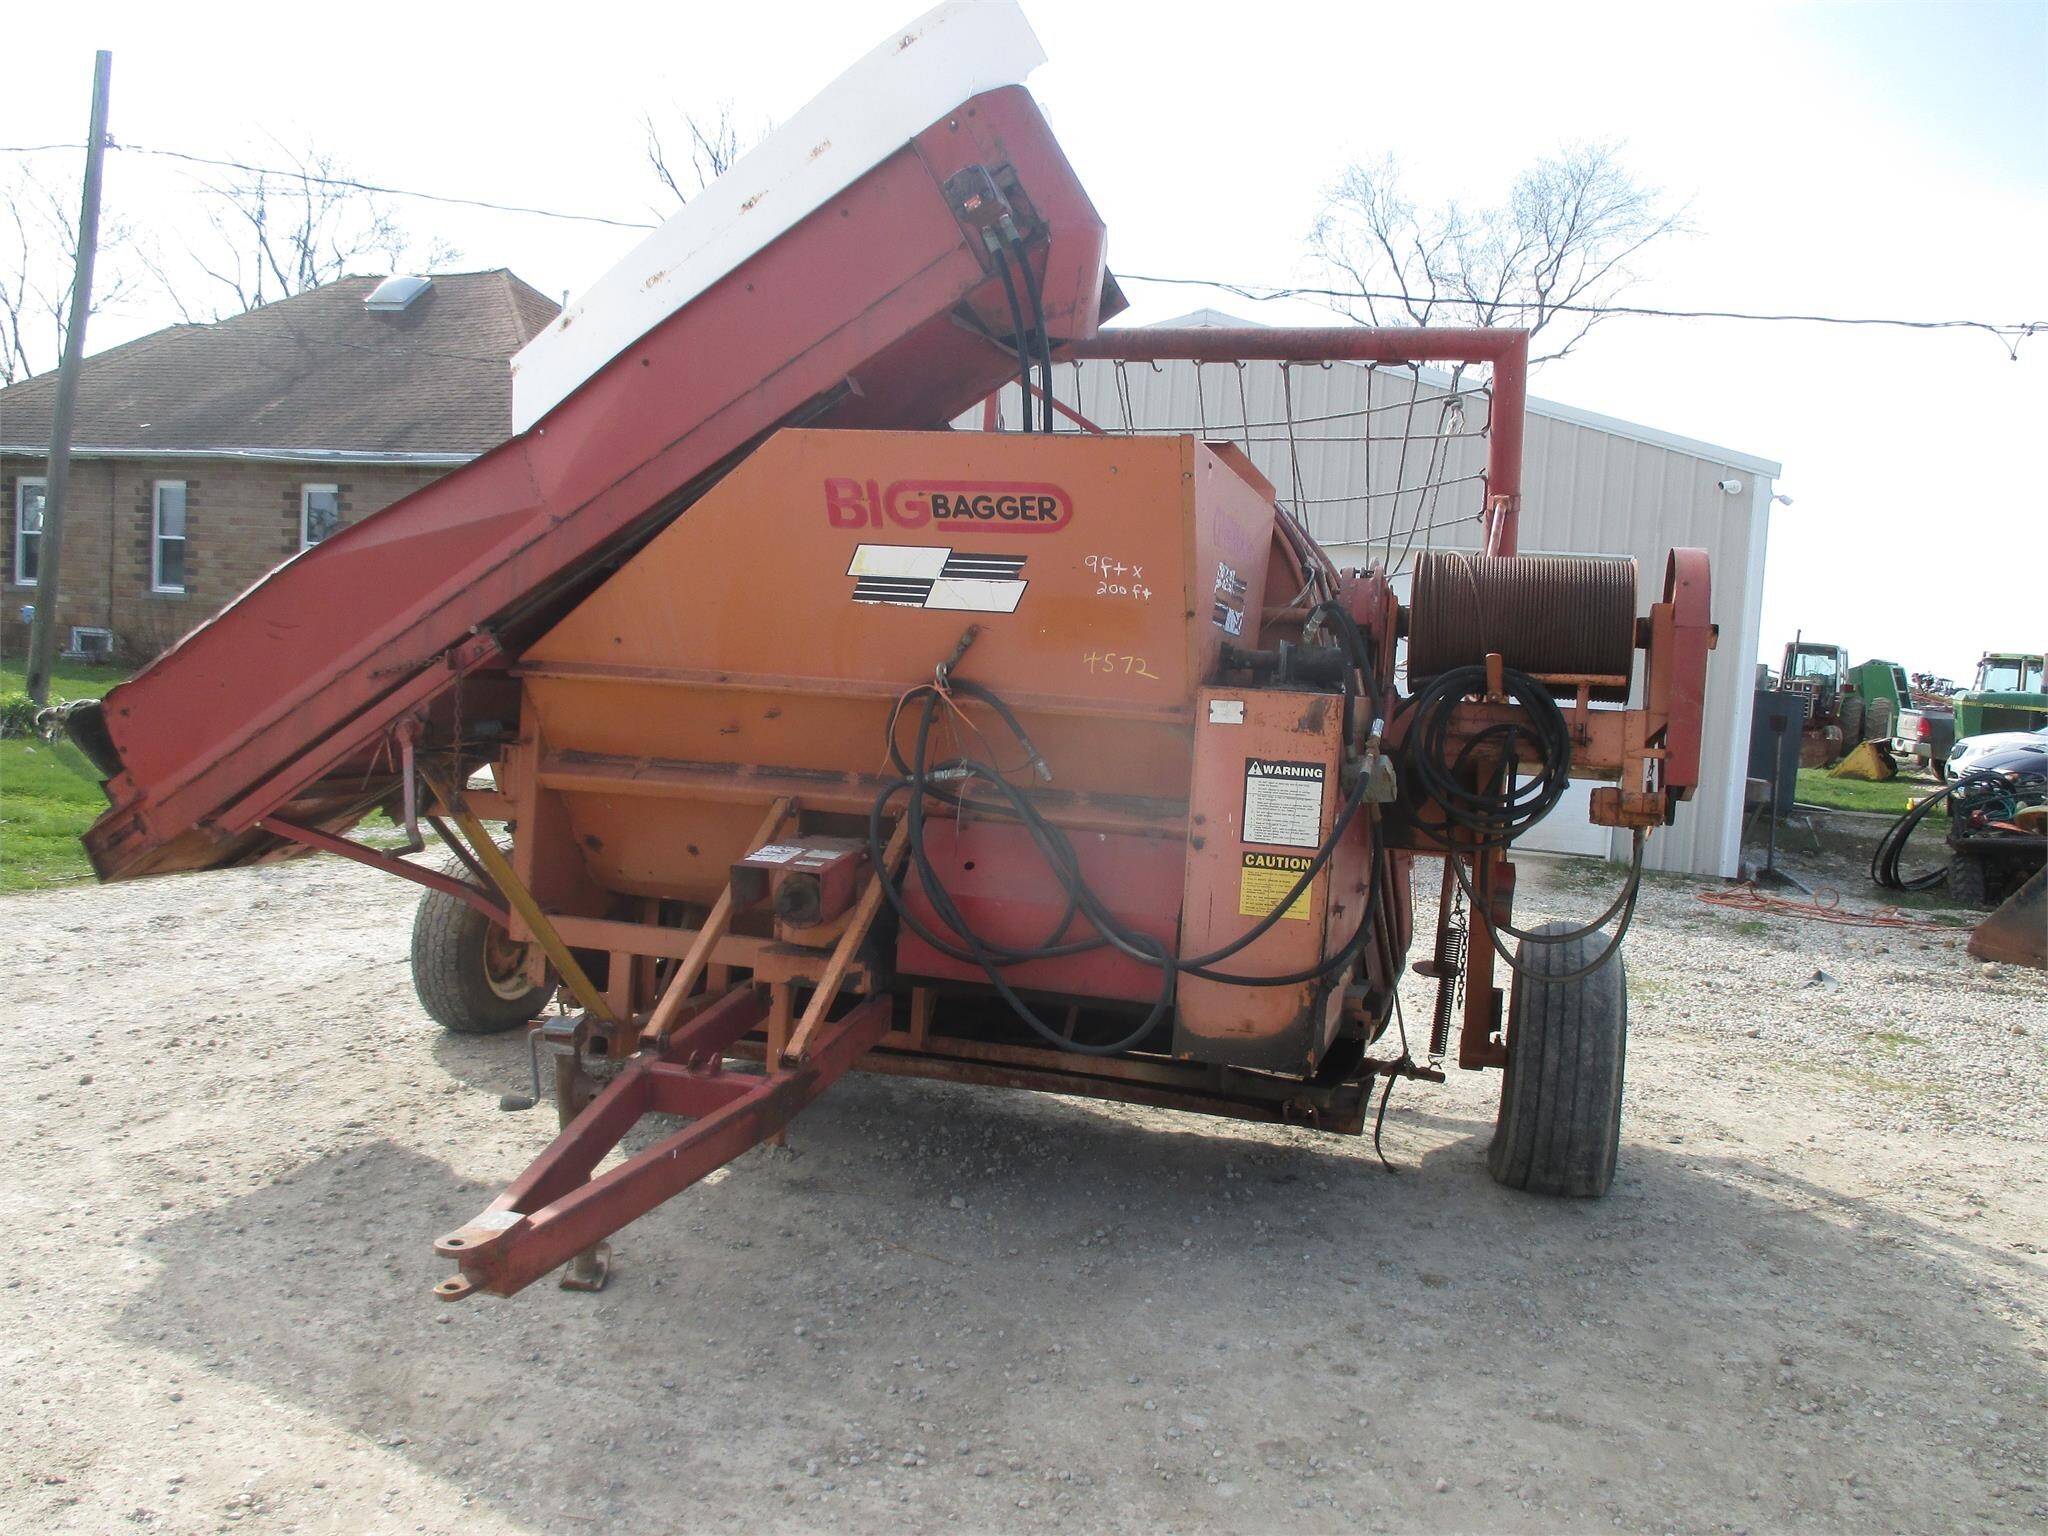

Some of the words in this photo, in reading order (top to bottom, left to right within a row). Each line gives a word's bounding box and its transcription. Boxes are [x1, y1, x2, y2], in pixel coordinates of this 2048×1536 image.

[824, 478, 932, 529] BIG
[931, 494, 1057, 521] BAGGER
[1096, 581, 1127, 595] 200
[1132, 584, 1152, 600] ft
[1082, 652, 1159, 679] 4572
[1263, 765, 1323, 778] WARNING
[1245, 854, 1312, 870] CAUTION
